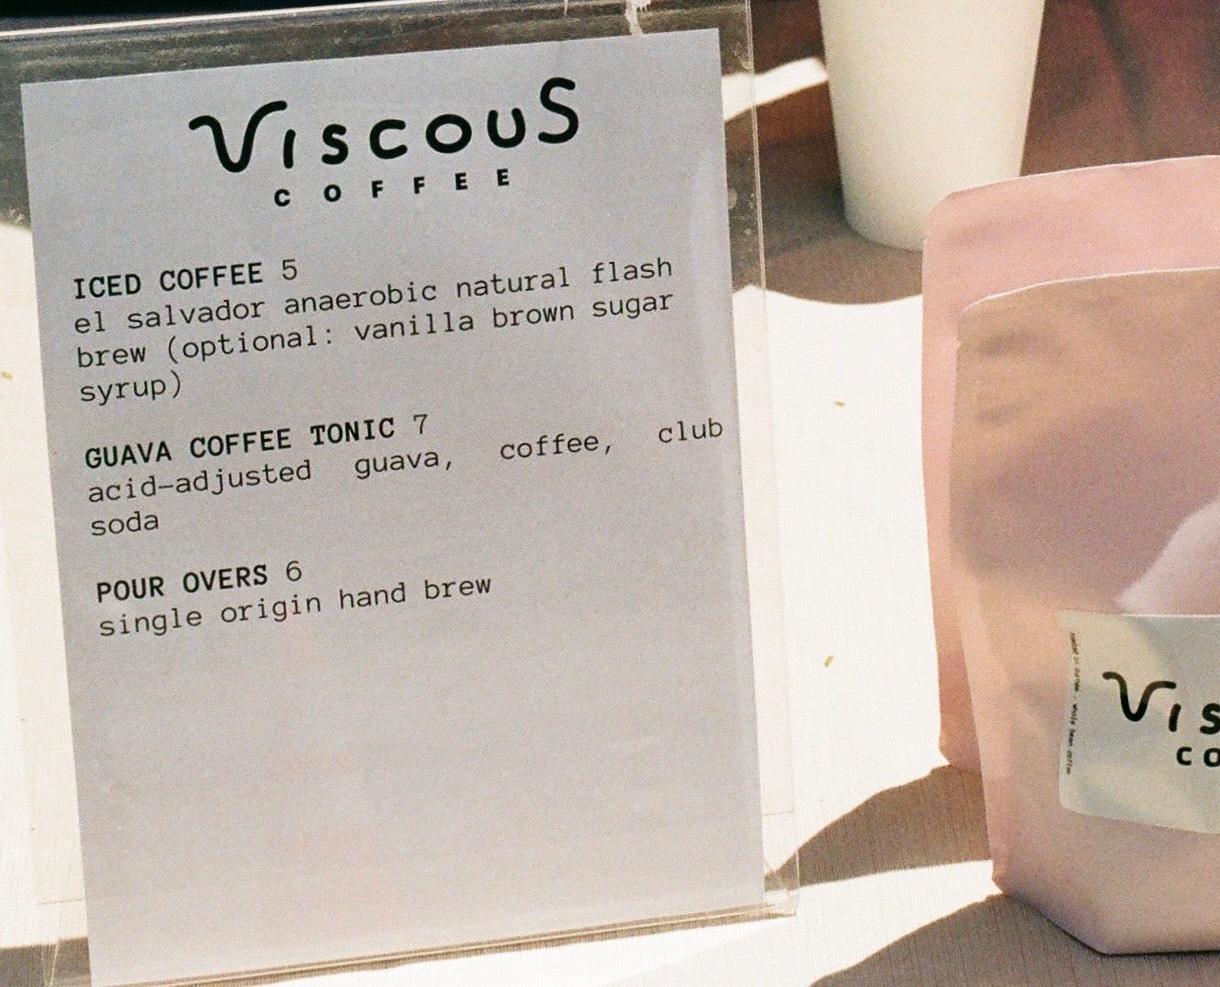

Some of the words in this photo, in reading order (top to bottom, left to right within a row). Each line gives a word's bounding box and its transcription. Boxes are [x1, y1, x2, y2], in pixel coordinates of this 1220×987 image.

[273, 167, 510, 208] COFFEE
[73, 273, 142, 300] ICED
[159, 261, 264, 292] COFFEE
[282, 258, 298, 281] 5
[74, 310, 106, 335] el
[127, 298, 265, 331] salvador
[284, 281, 437, 317] anaerobic
[456, 266, 570, 298] natural
[592, 256, 672, 284] flash
[77, 346, 146, 368] brew
[167, 324, 332, 365] (optional:
[354, 311, 474, 341] vanilla
[492, 304, 575, 329] brown
[592, 293, 674, 320] sugar
[80, 369, 181, 407] syrup)
[84, 440, 173, 470] GUAVA
[189, 427, 292, 459] COFFEE
[309, 416, 395, 446] TONIC
[413, 413, 428, 435] 7
[86, 458, 313, 504] acid-adjusted
[354, 451, 452, 480] guava,
[499, 432, 611, 460] coffee,
[658, 417, 723, 444] club
[91, 510, 159, 537] soda
[96, 575, 165, 604] POUR
[182, 563, 268, 594] OVERS
[285, 560, 303, 582] 6
[99, 607, 203, 637] single
[220, 593, 321, 623] origin
[339, 581, 406, 610] hand
[424, 578, 492, 600] brew
